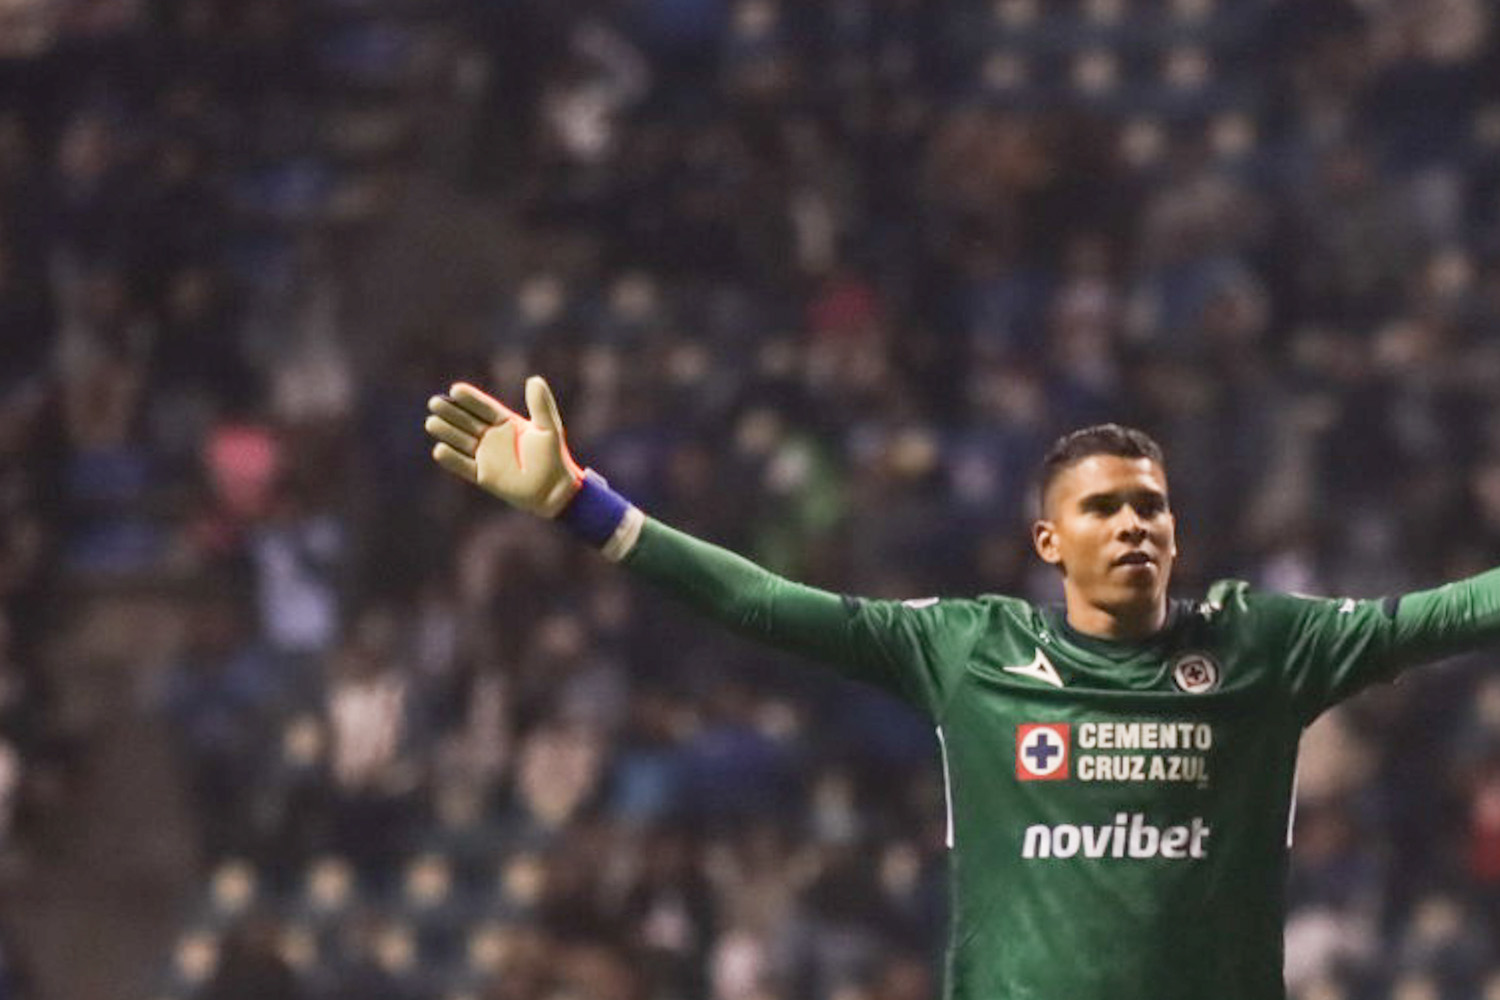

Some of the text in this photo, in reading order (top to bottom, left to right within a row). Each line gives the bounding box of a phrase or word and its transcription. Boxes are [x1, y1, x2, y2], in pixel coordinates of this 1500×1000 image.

[1078, 722, 1212, 750] CEMENTO
[1077, 754, 1209, 781] CRUZ AZUL
[1021, 812, 1210, 859] novibet
